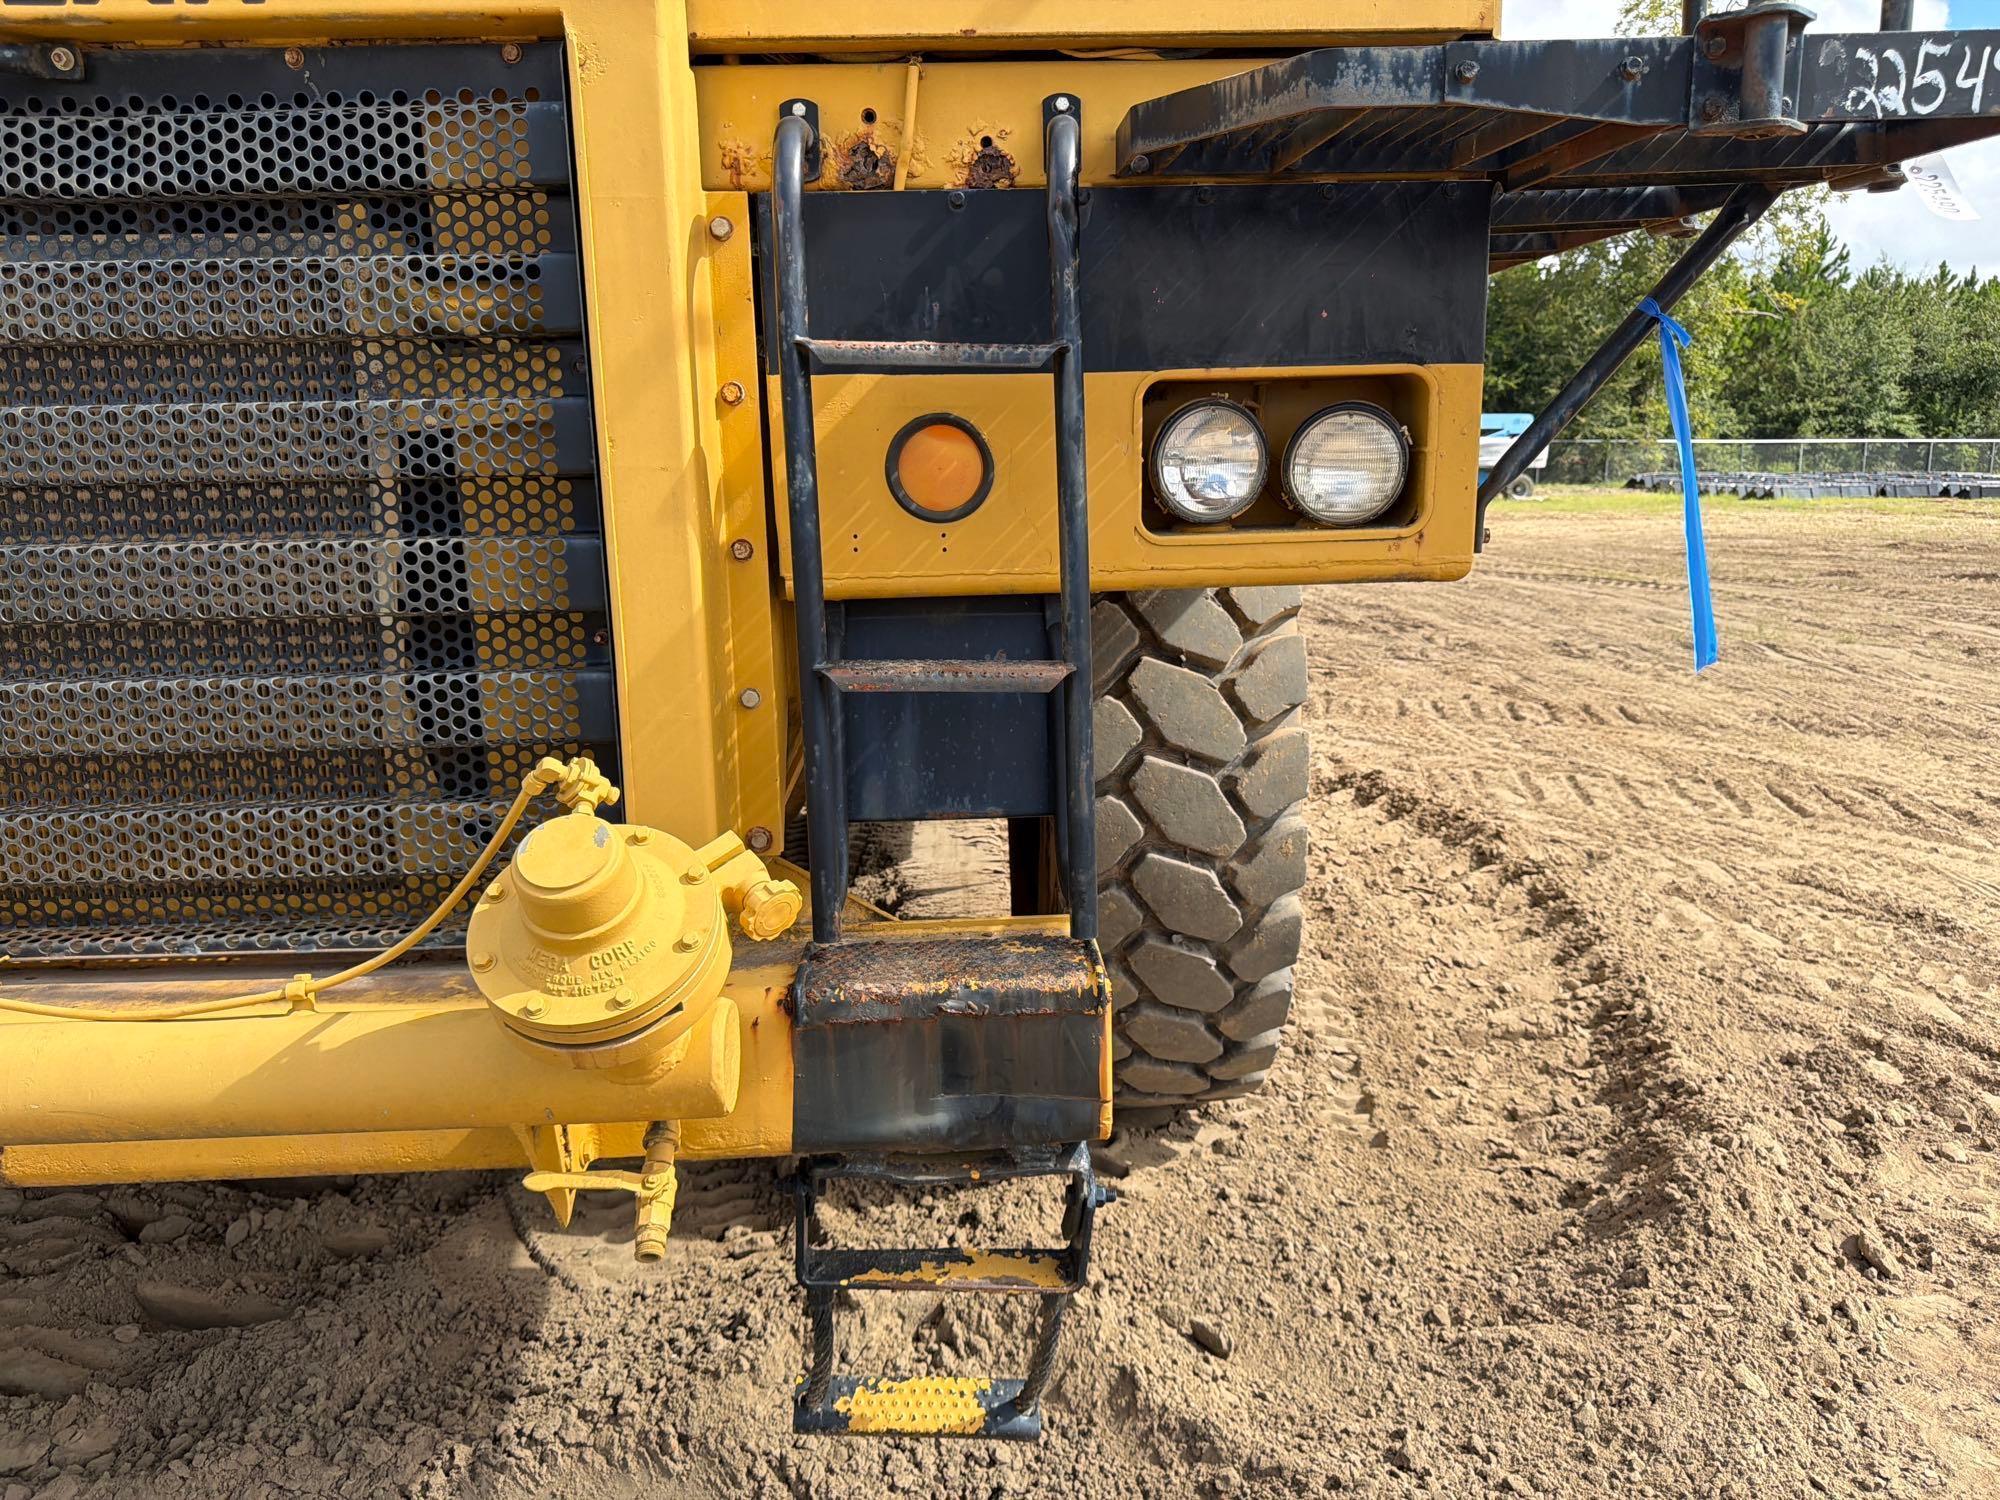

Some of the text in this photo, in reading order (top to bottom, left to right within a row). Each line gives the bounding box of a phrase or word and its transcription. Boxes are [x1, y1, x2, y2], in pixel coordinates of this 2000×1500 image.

[526, 939, 635, 974] MEGA CORP
[619, 939, 657, 972] MEXICO
